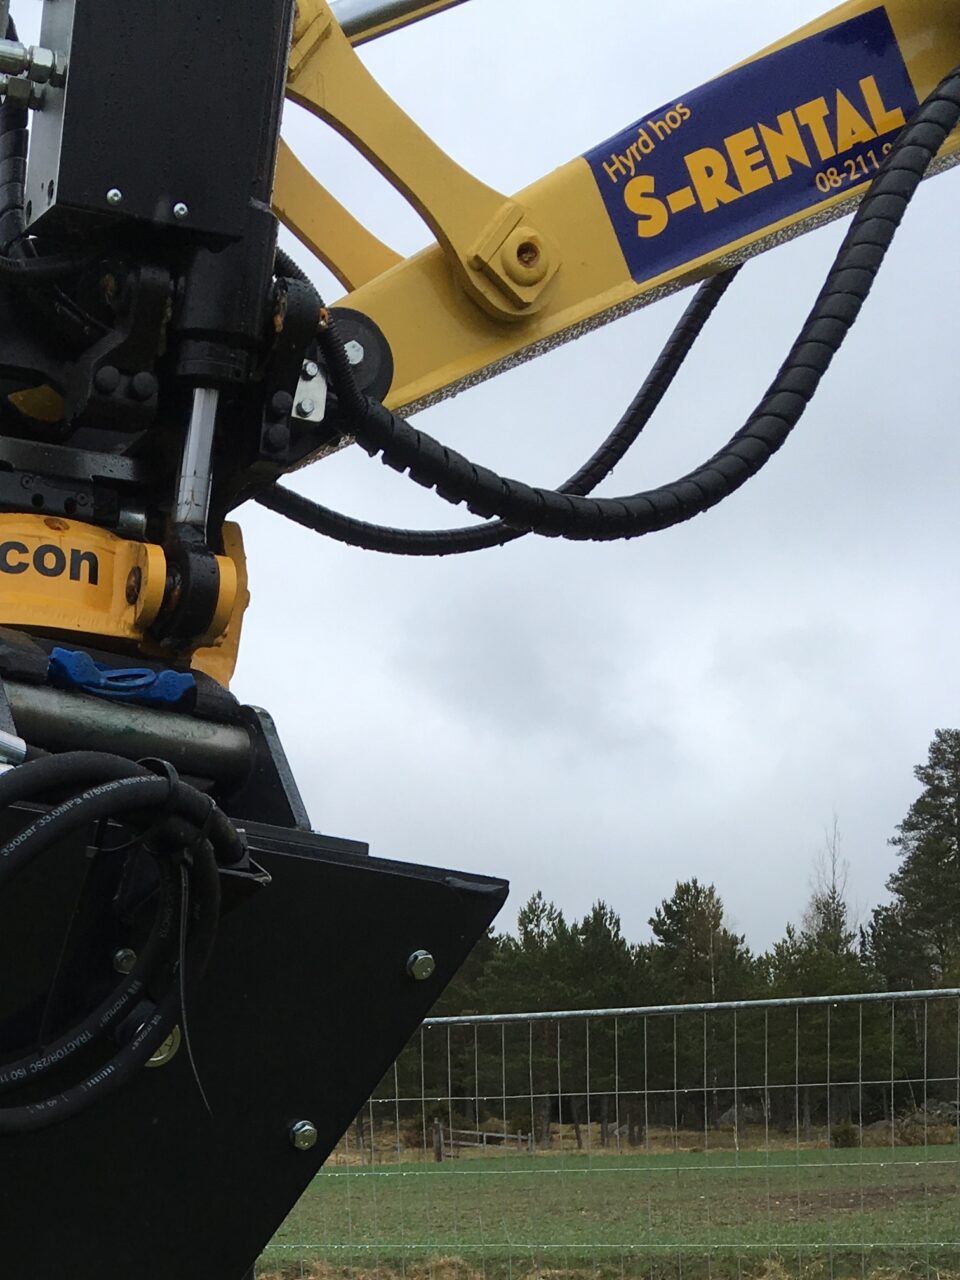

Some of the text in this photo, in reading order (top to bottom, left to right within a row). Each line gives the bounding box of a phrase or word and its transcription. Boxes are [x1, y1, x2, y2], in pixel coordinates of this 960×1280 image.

[602, 102, 692, 183] Hyrd hos
[623, 75, 906, 237] S-RENTAL
[0, 823, 37, 857] 330bar
